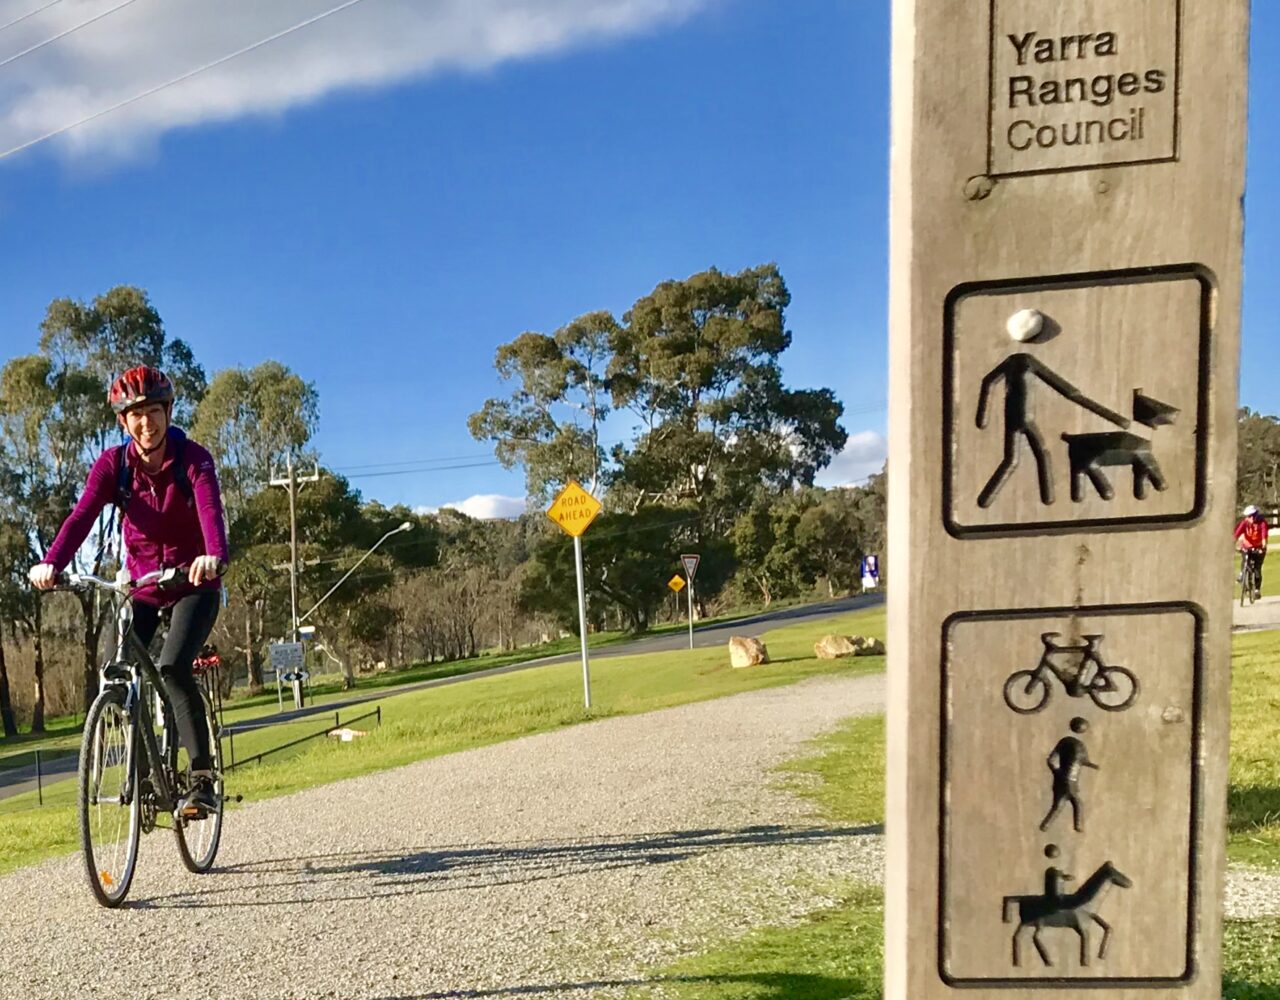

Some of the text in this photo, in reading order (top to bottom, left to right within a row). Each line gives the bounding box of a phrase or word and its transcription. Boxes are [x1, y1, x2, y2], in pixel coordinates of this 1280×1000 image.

[1006, 30, 1118, 65] Yarra
[1007, 68, 1166, 108] Ranges
[1006, 106, 1145, 151] Council
[559, 508, 591, 522] AHEAD
[561, 495, 586, 507] ROAD
